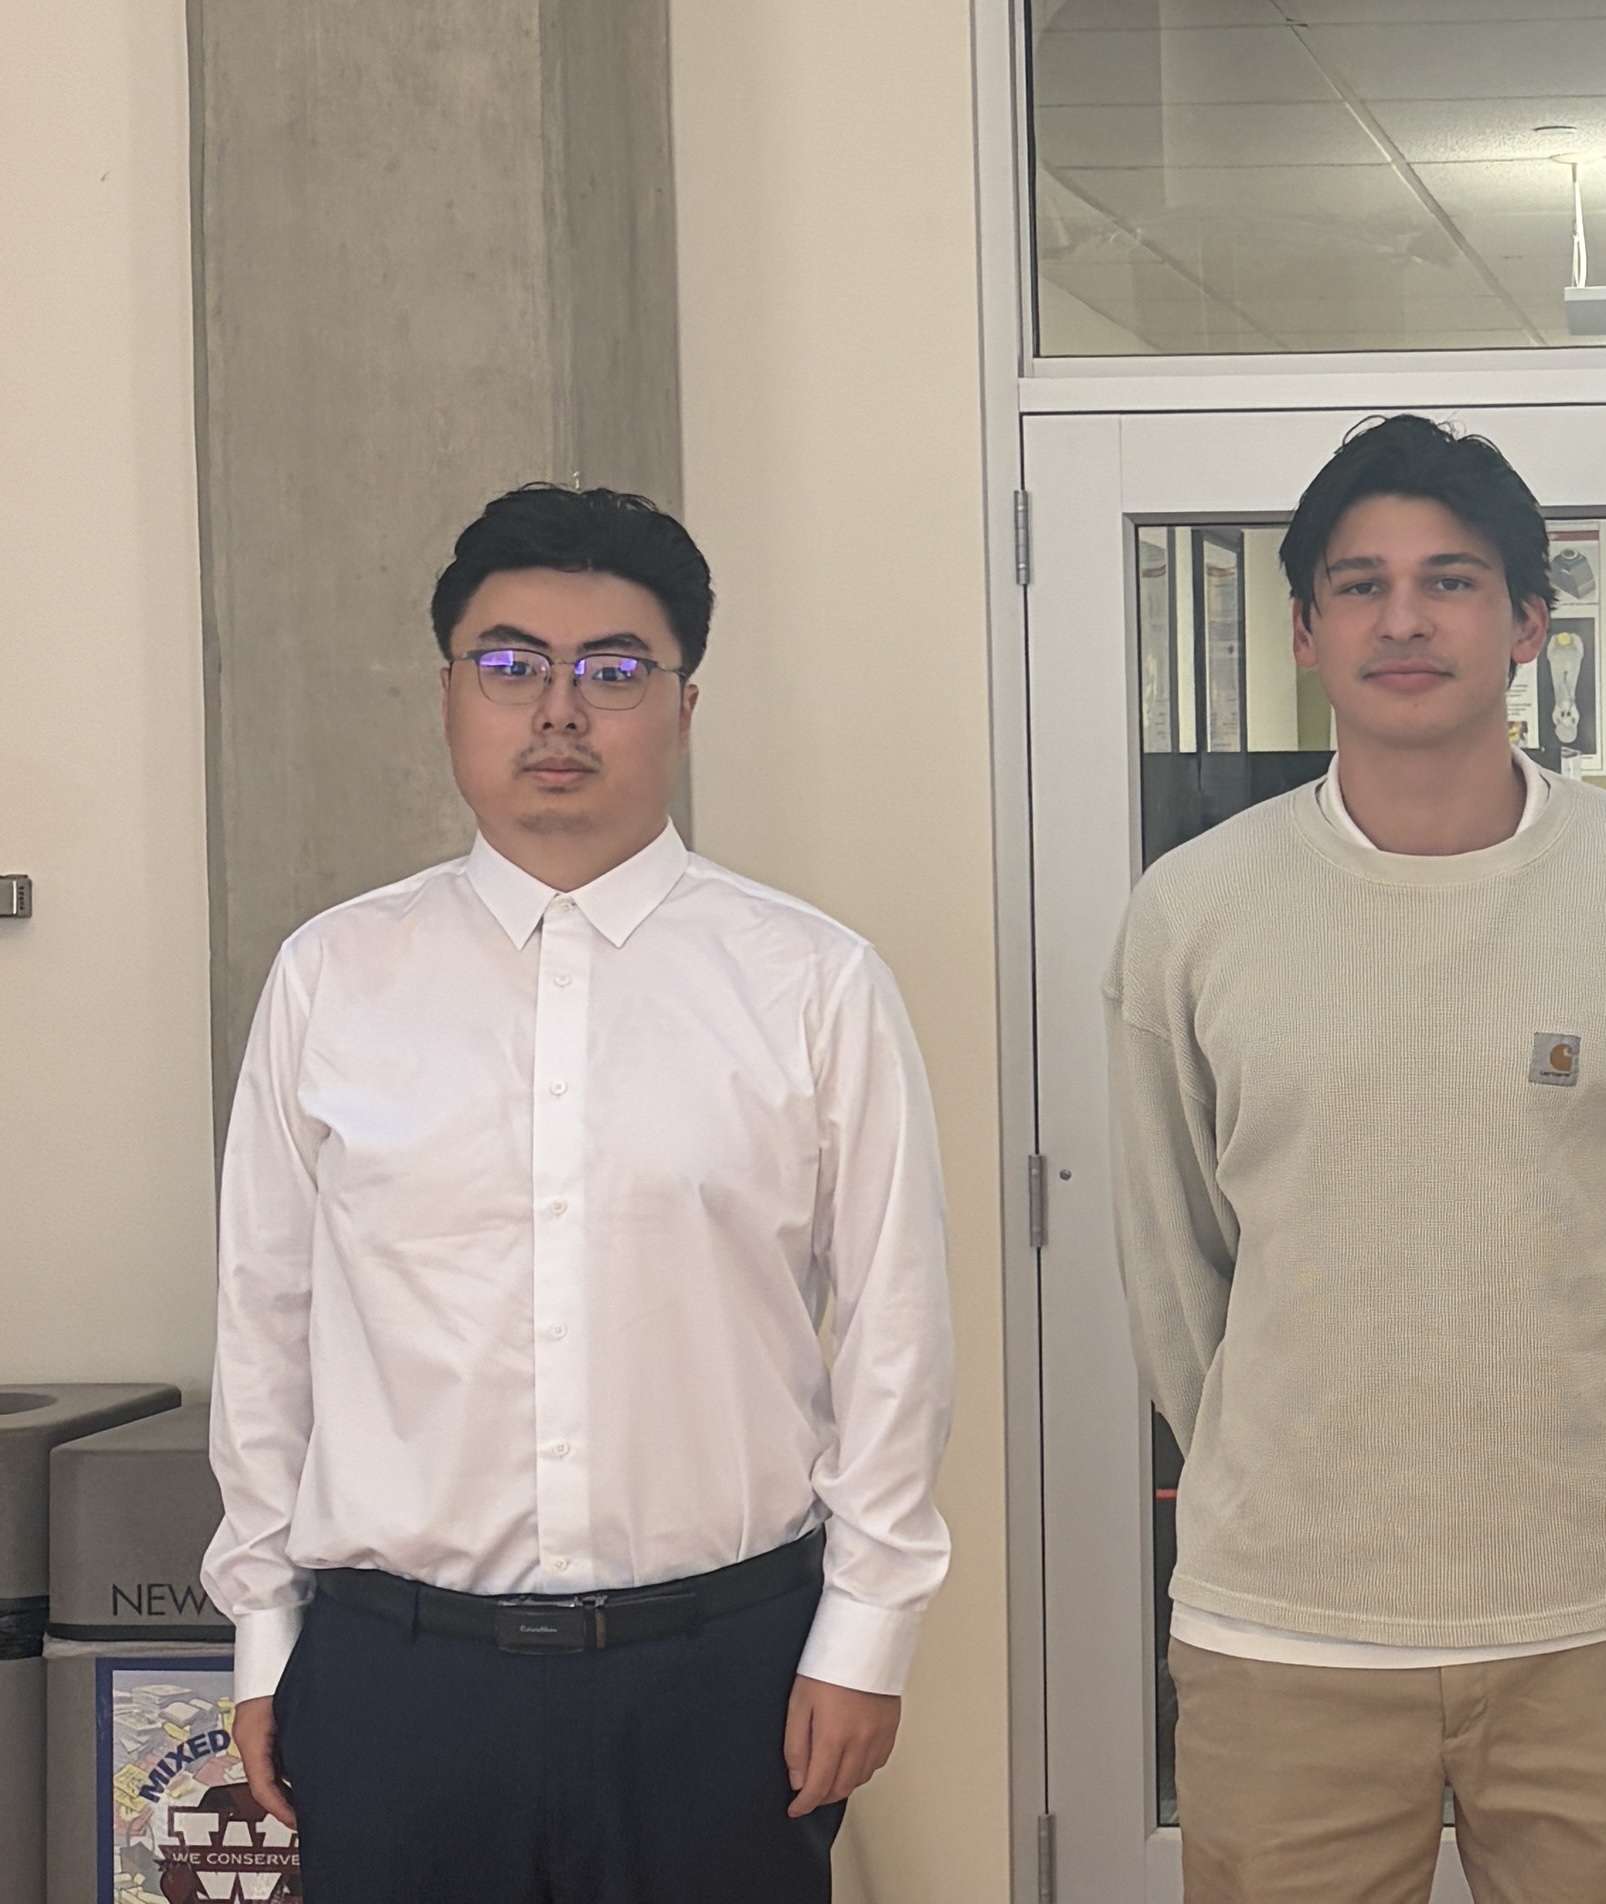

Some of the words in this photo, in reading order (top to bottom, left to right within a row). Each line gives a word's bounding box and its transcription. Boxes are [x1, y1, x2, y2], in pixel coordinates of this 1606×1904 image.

[112, 1583, 226, 1616] NEW
[139, 1729, 231, 1804] MIXED
[173, 1852, 201, 1864] WE
[206, 1852, 300, 1865] CONSERVE
